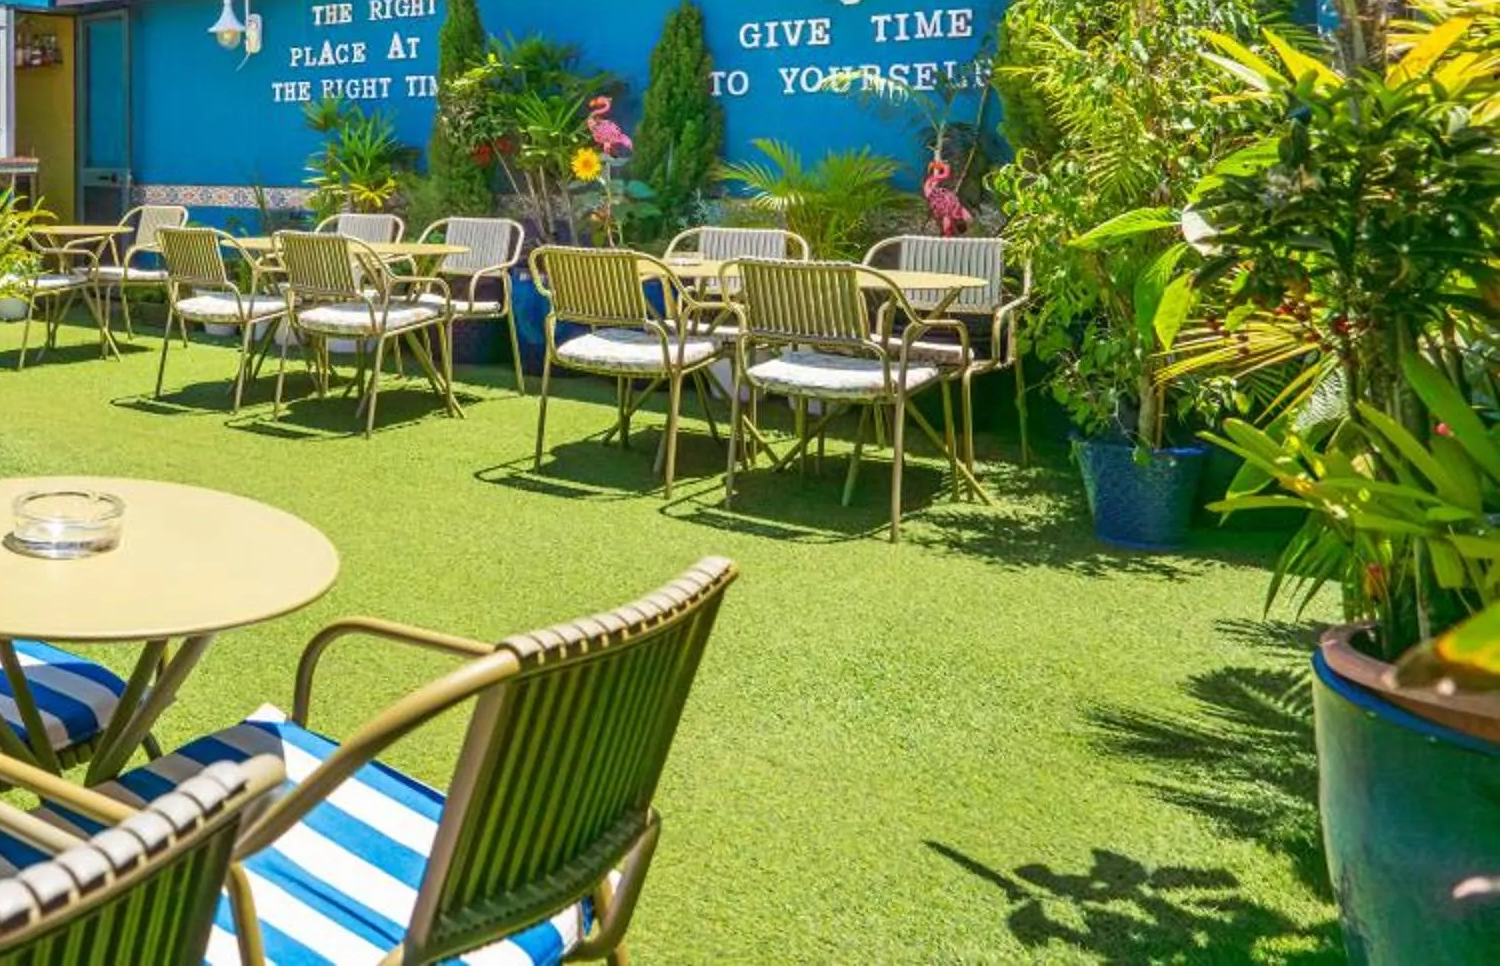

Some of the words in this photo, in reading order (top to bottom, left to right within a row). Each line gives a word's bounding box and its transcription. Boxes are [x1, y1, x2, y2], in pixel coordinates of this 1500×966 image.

[312, 3, 353, 26] THE
[739, 18, 831, 48] GIVE
[870, 8, 973, 42] TIME
[290, 40, 366, 67] PLACE
[387, 32, 420, 60] AT
[271, 81, 311, 102] THE
[321, 77, 392, 99] RIGHT
[405, 75, 438, 97] TIM
[708, 70, 749, 96] TO
